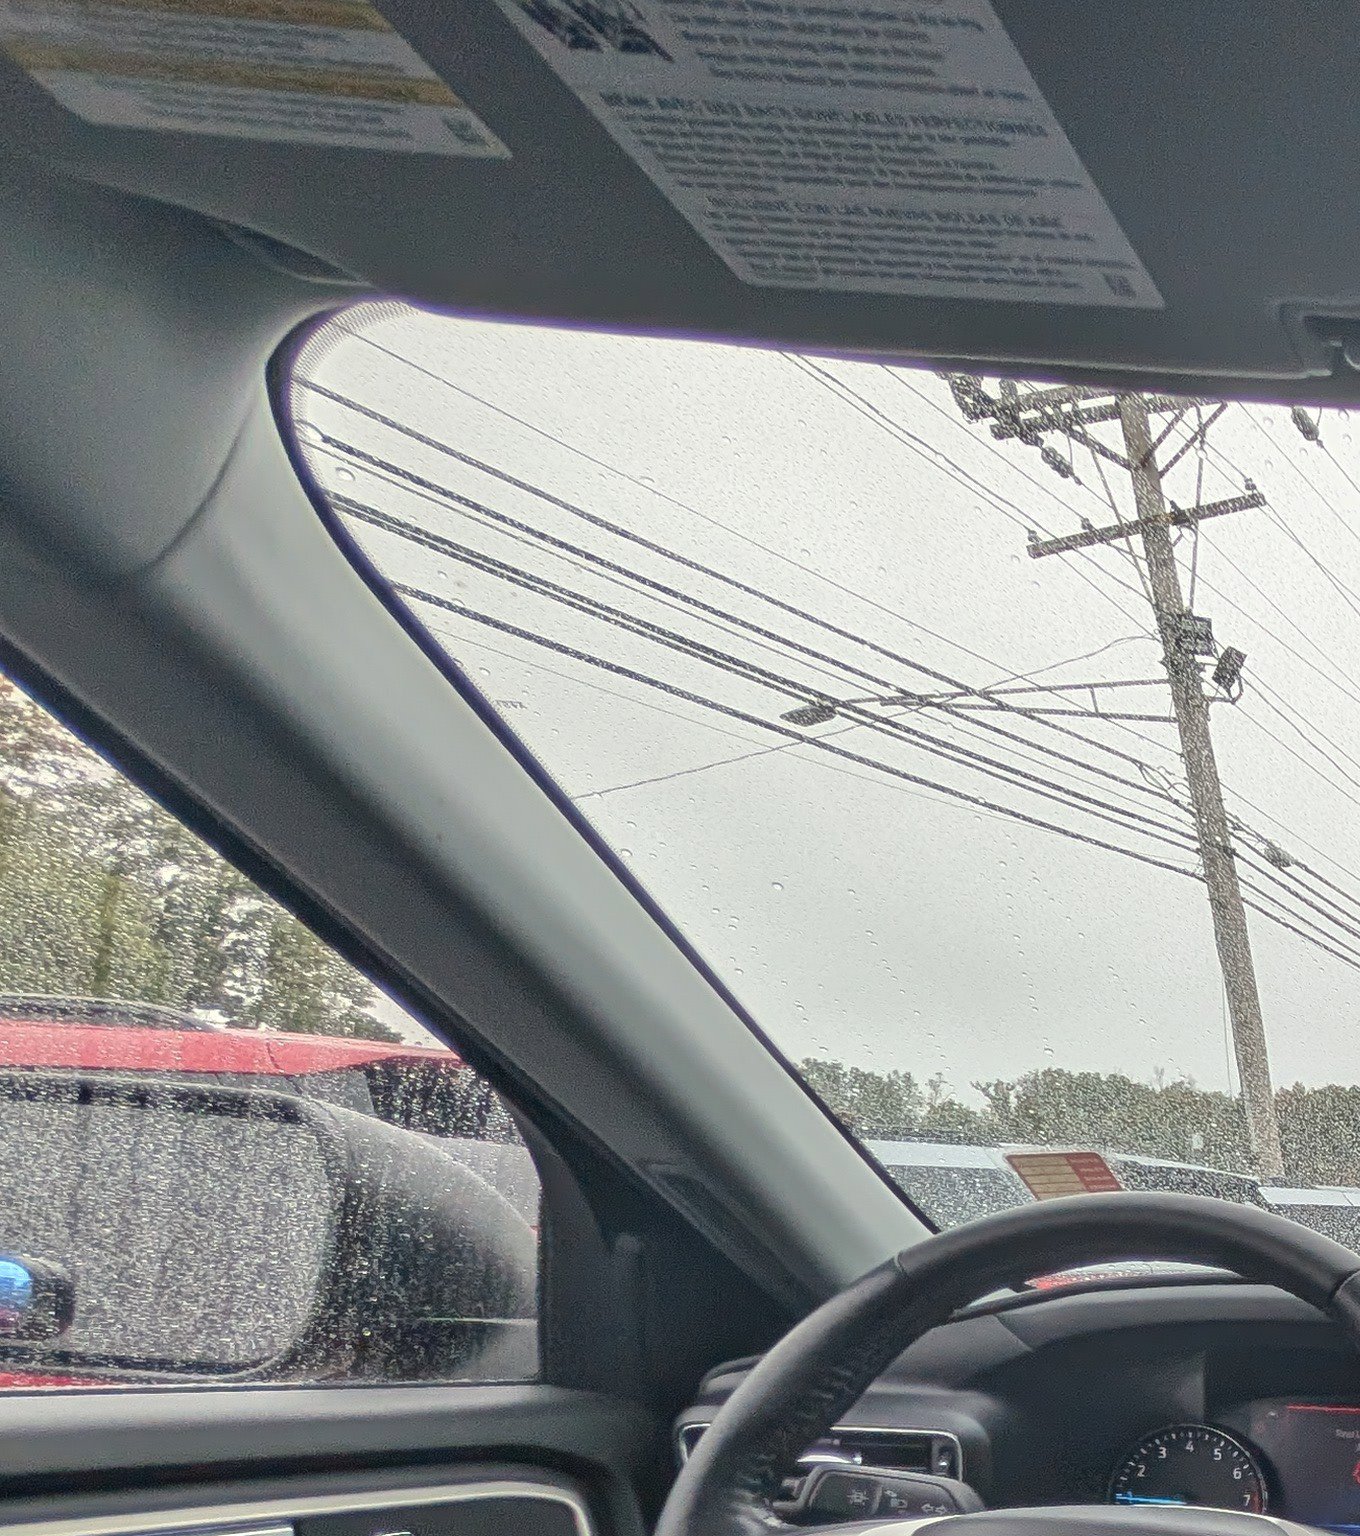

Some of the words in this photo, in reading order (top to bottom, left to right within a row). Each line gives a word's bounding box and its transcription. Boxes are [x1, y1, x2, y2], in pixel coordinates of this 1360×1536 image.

[1158, 1446, 1167, 1459] 3
[1185, 1440, 1194, 1453] 4
[1213, 1448, 1222, 1461] 5
[1136, 1464, 1146, 1478] 2
[1232, 1467, 1242, 1480] 6
[1243, 1493, 1251, 1507] 7
